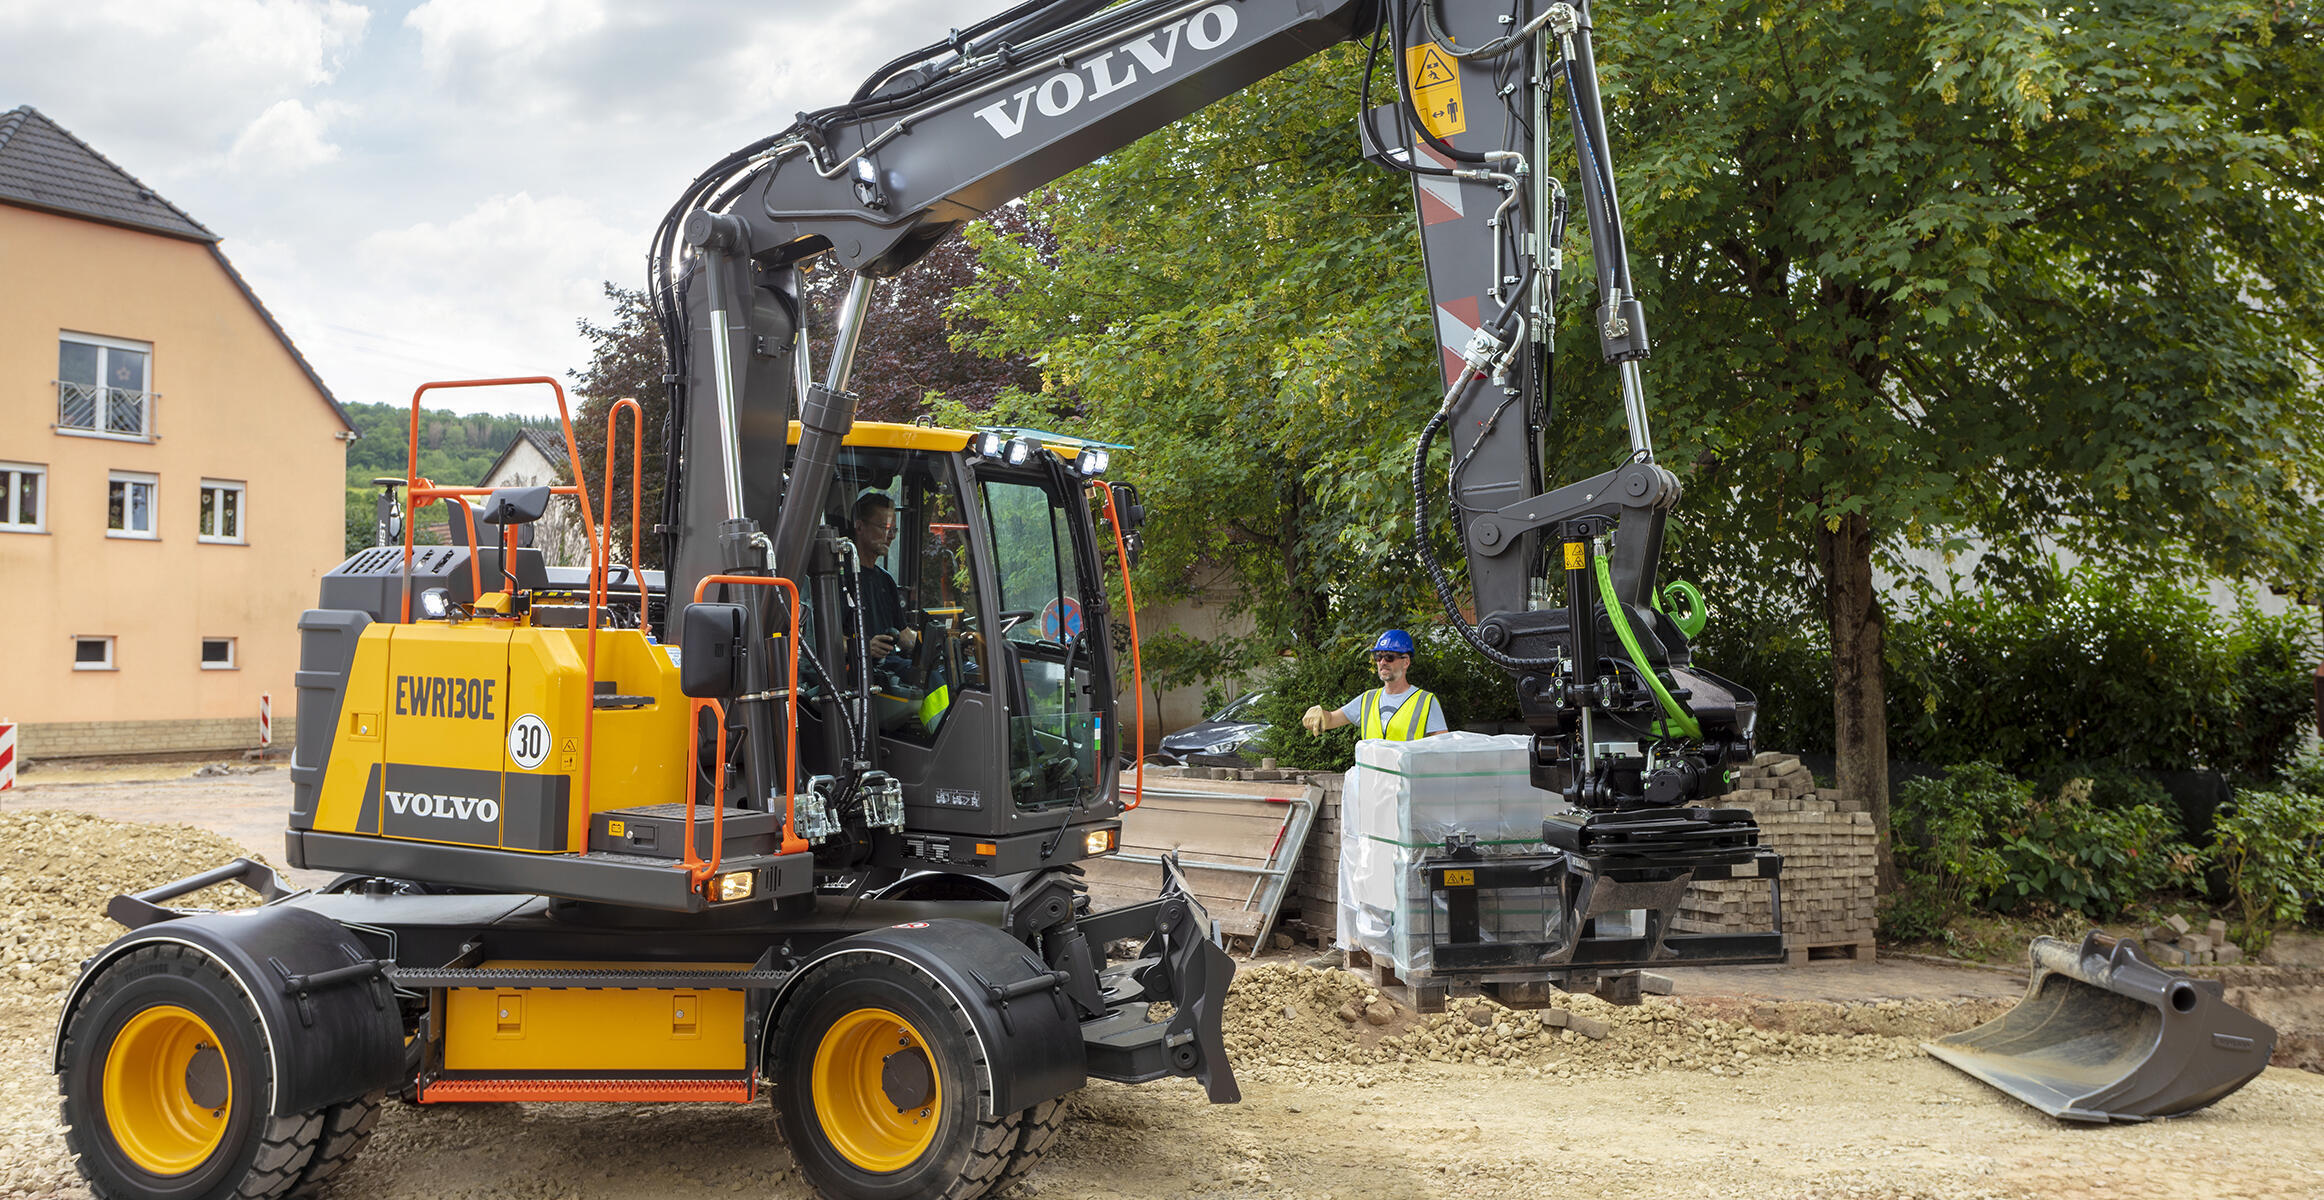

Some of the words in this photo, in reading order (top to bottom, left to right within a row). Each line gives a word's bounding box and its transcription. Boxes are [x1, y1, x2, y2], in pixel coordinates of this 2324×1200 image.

[973, 4, 1238, 139] VOLVO
[395, 675, 496, 720] EWR130E
[516, 724, 542, 758] 30
[385, 791, 499, 823] VOLVO
